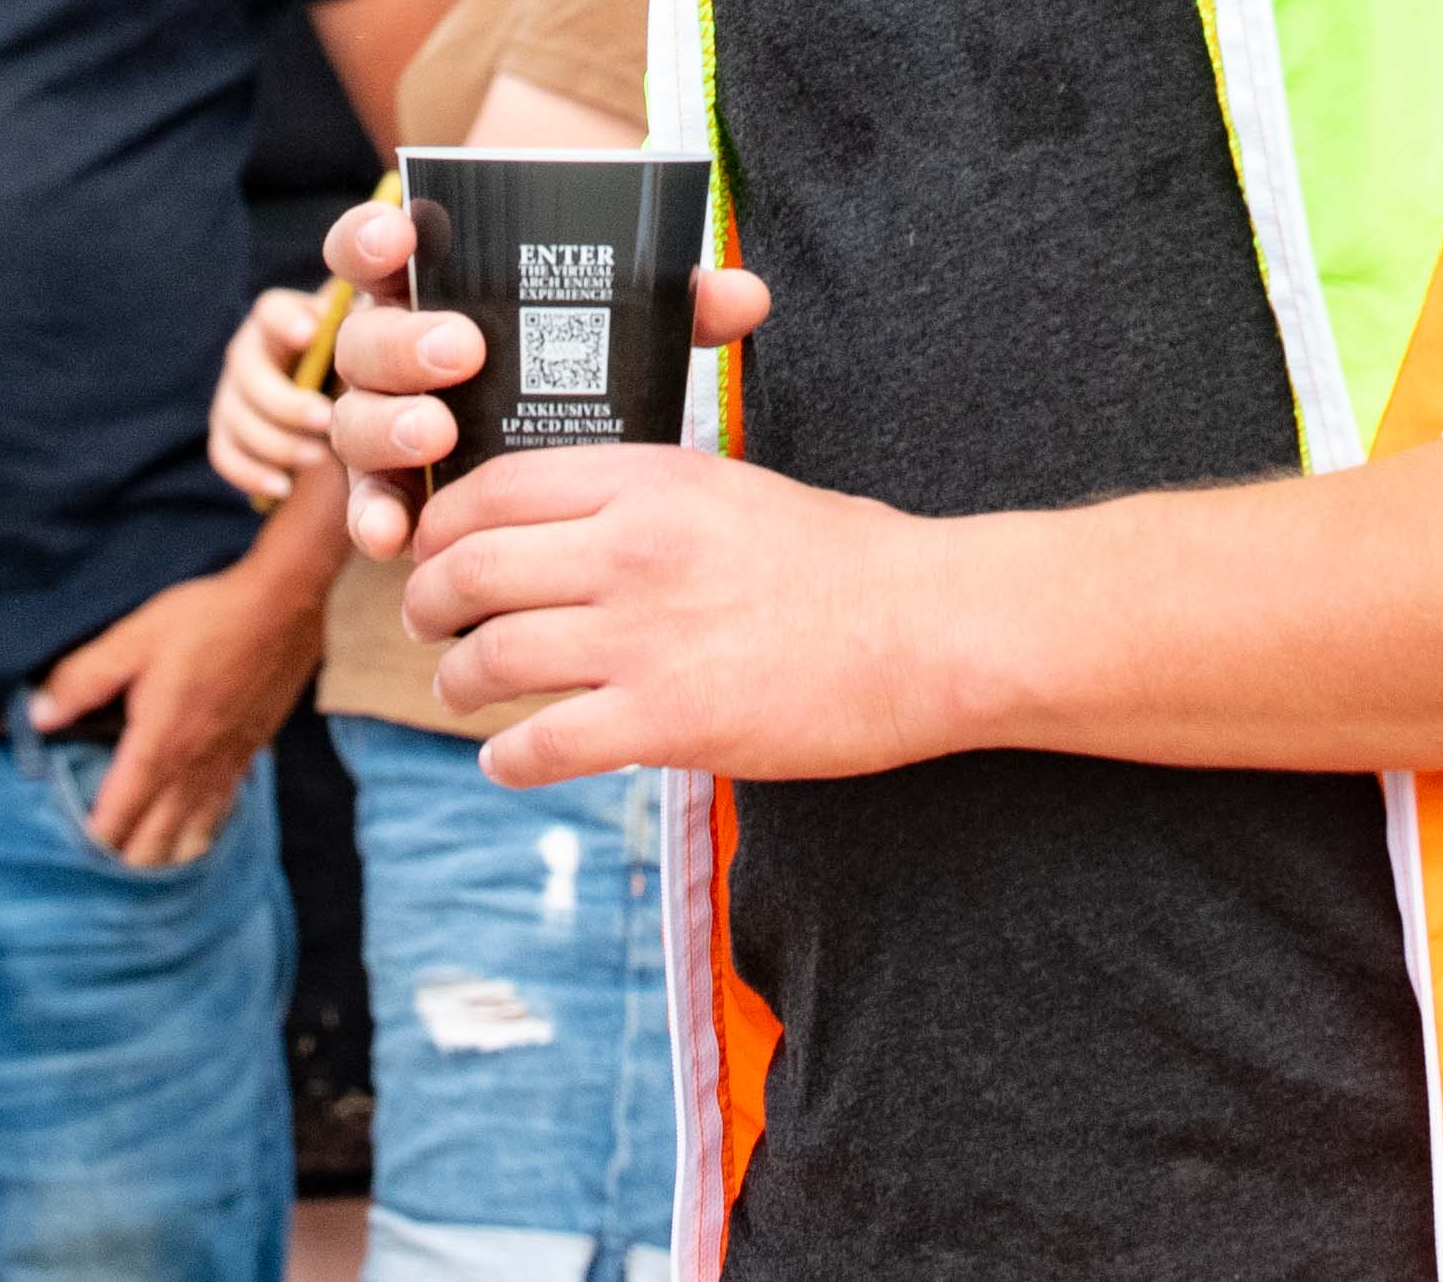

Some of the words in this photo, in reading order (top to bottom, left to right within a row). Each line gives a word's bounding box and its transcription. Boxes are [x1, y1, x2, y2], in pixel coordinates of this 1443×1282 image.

[519, 244, 615, 266] ENTER
[519, 265, 549, 277] THE
[552, 265, 614, 277] VIRTUAL
[519, 276, 560, 288] ARCH
[563, 276, 613, 288] ENEMY
[519, 288, 613, 301] EXPERIENCE!
[517, 402, 611, 417] EXKLUSIVES
[502, 418, 521, 433] LP
[523, 418, 535, 433] &
[537, 418, 562, 433] CD
[564, 418, 624, 433] BUNDLE
